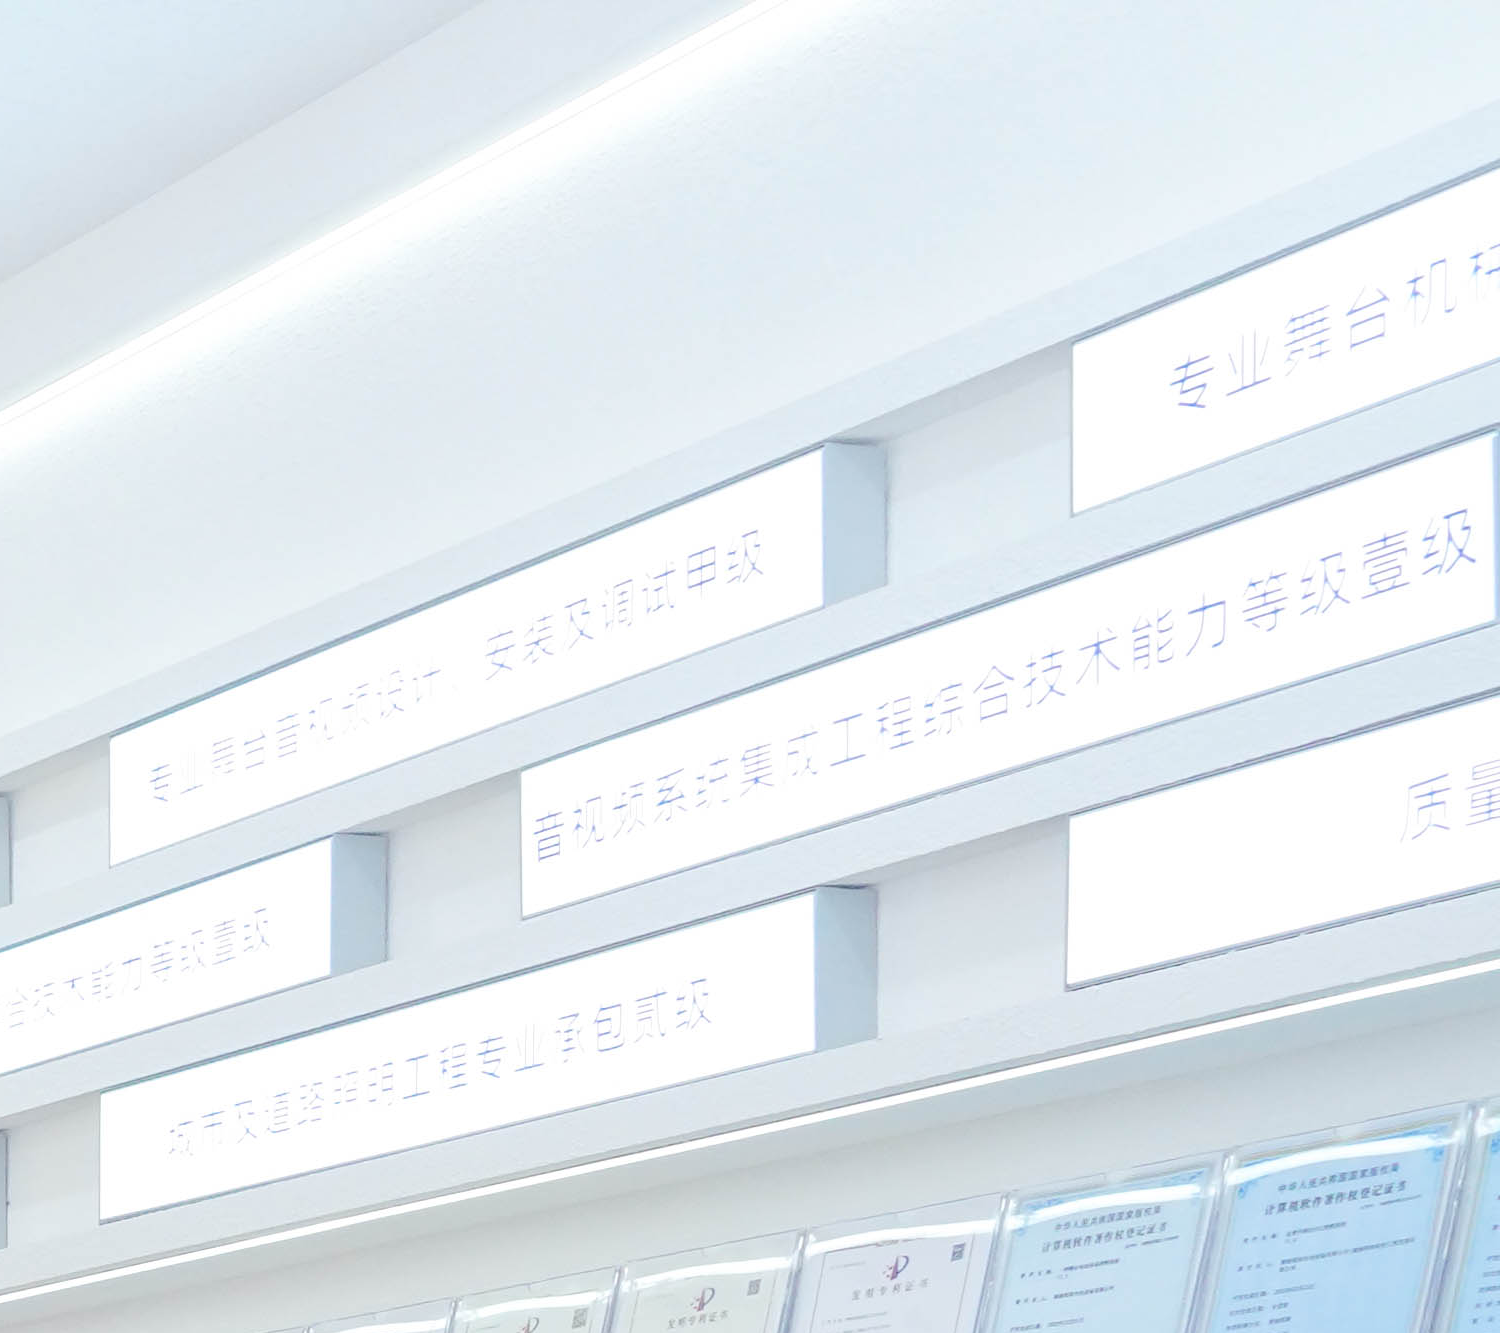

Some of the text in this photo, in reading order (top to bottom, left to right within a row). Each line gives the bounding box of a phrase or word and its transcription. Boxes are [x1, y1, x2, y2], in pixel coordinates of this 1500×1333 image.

[531, 505, 1482, 866] 音视频系统集成工程综合技术能力等级壹级
